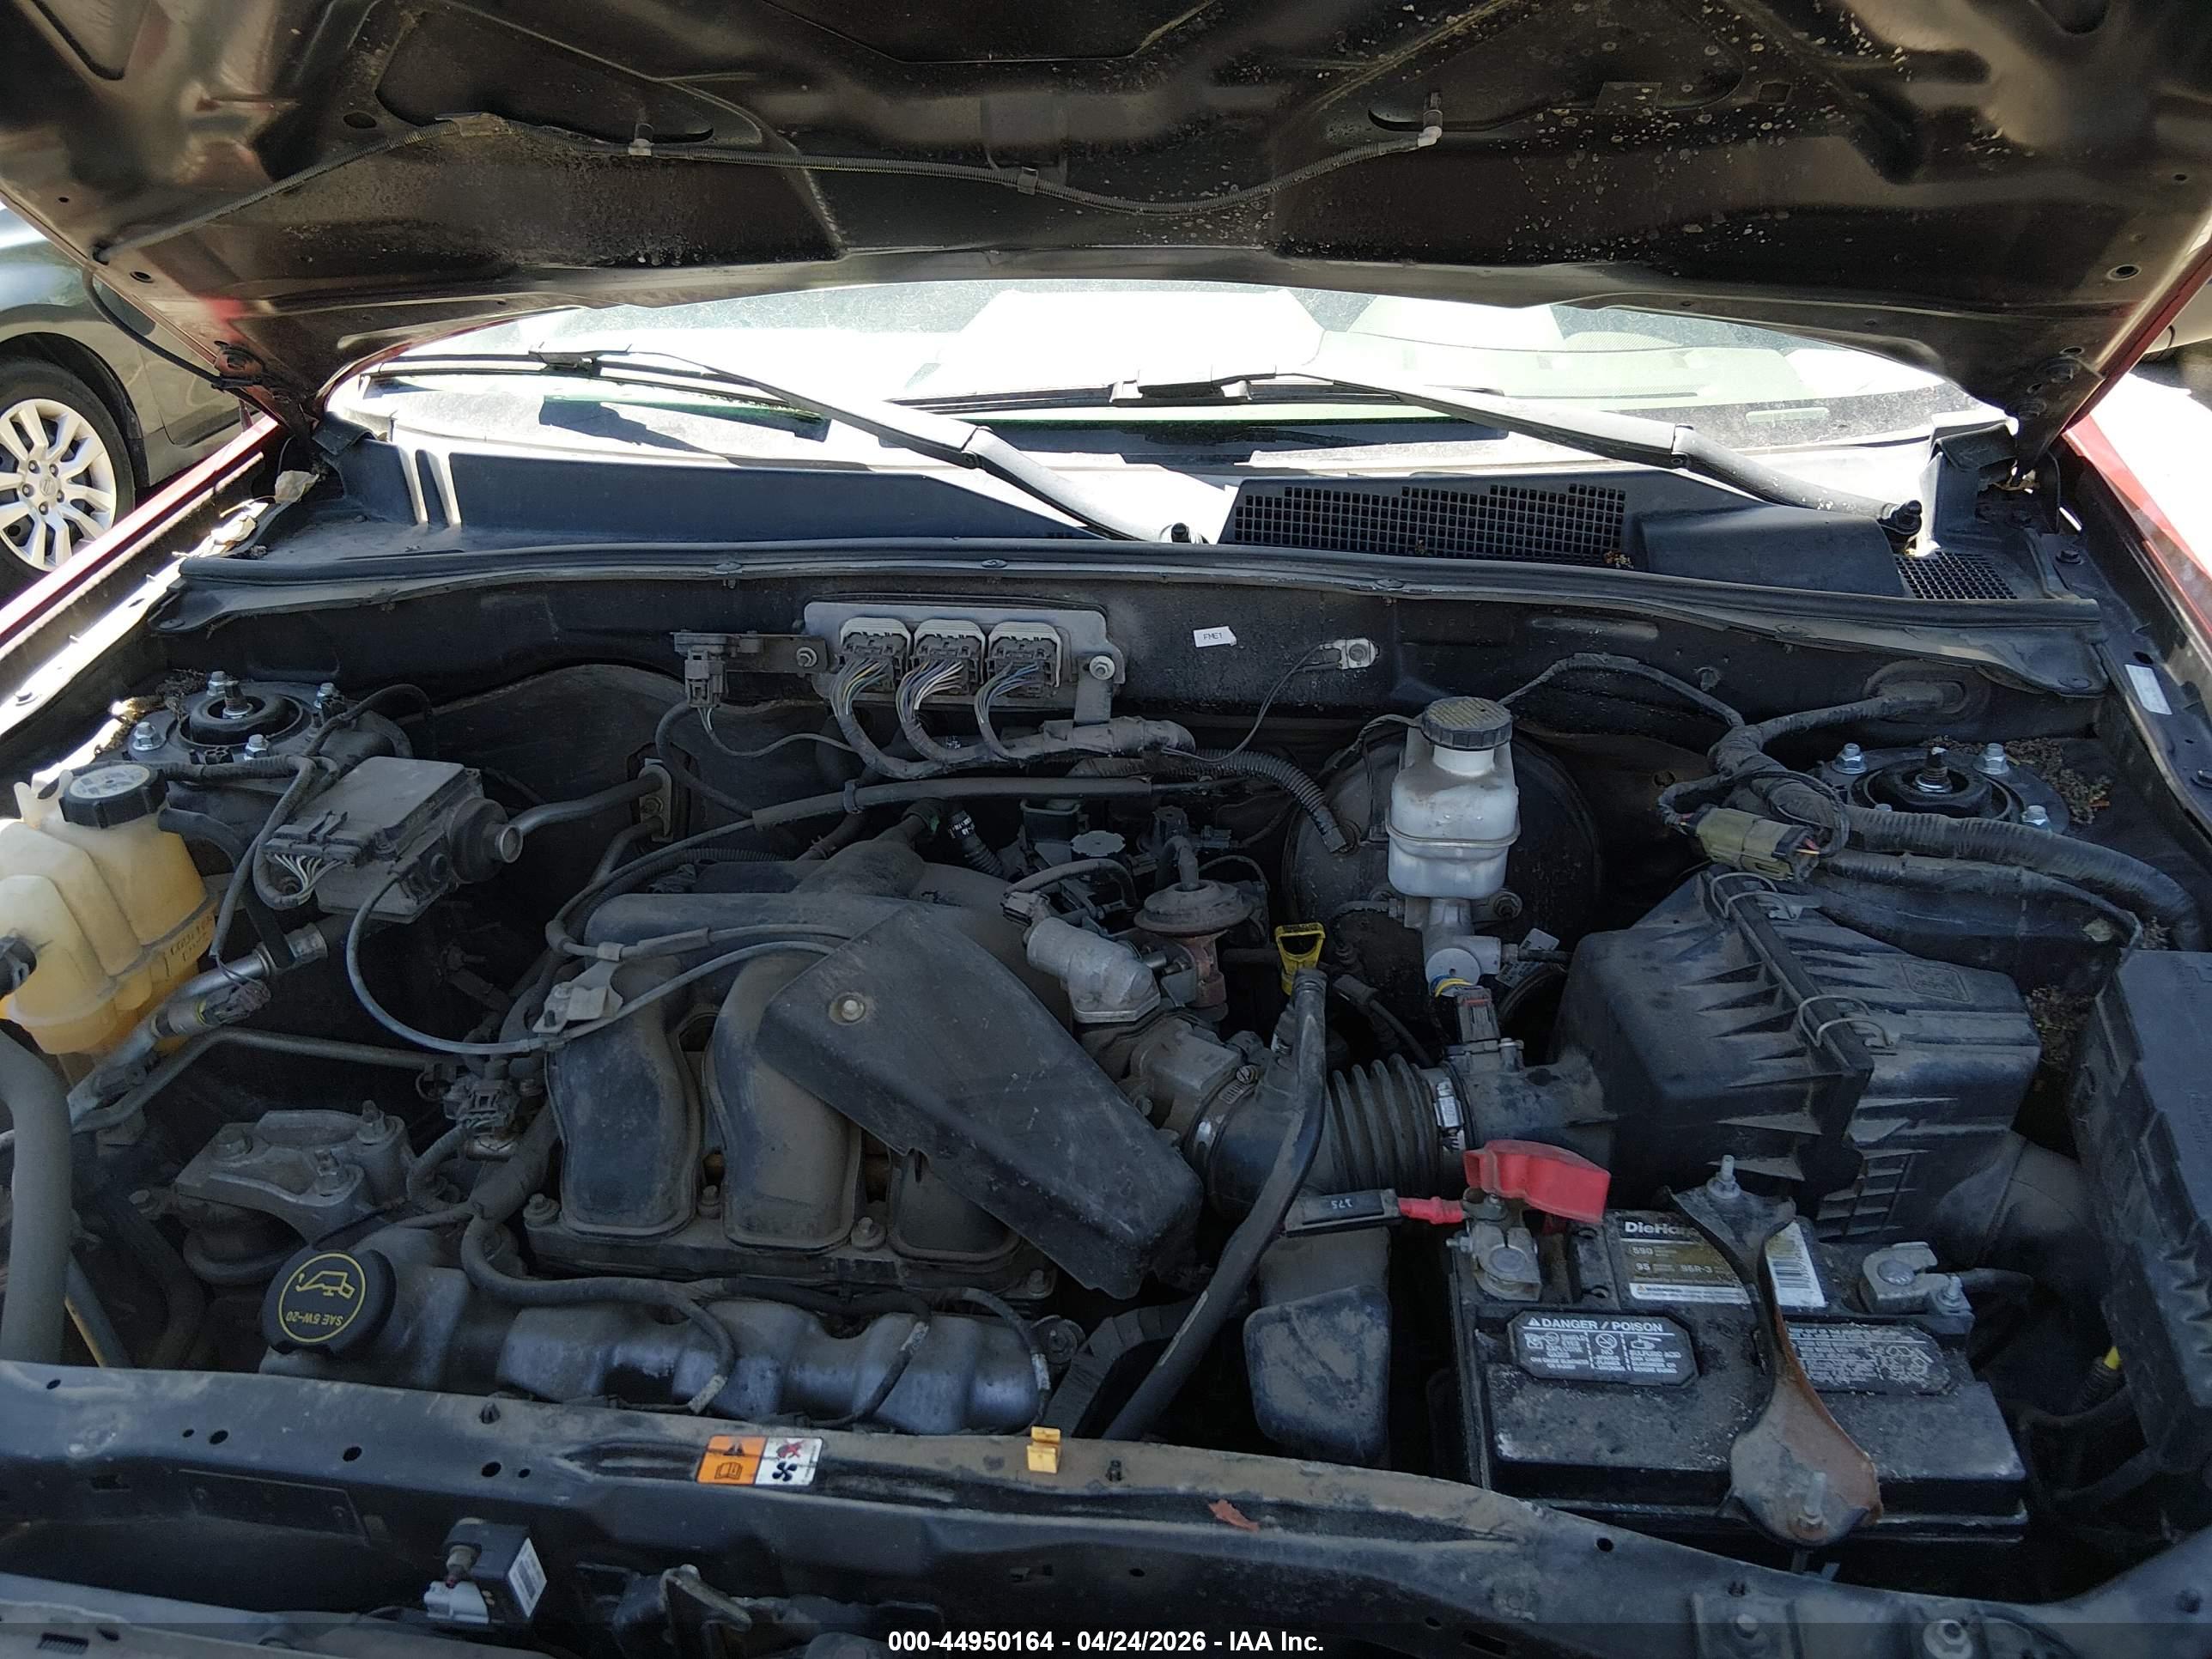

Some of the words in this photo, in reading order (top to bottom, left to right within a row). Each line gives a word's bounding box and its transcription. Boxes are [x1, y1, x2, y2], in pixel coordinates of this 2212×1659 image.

[285, 1310, 321, 1325] 5W-20
[322, 1314, 343, 1327] SAE
[1541, 1318, 1598, 1330] DANGER
[1612, 1322, 1663, 1332] POISON
